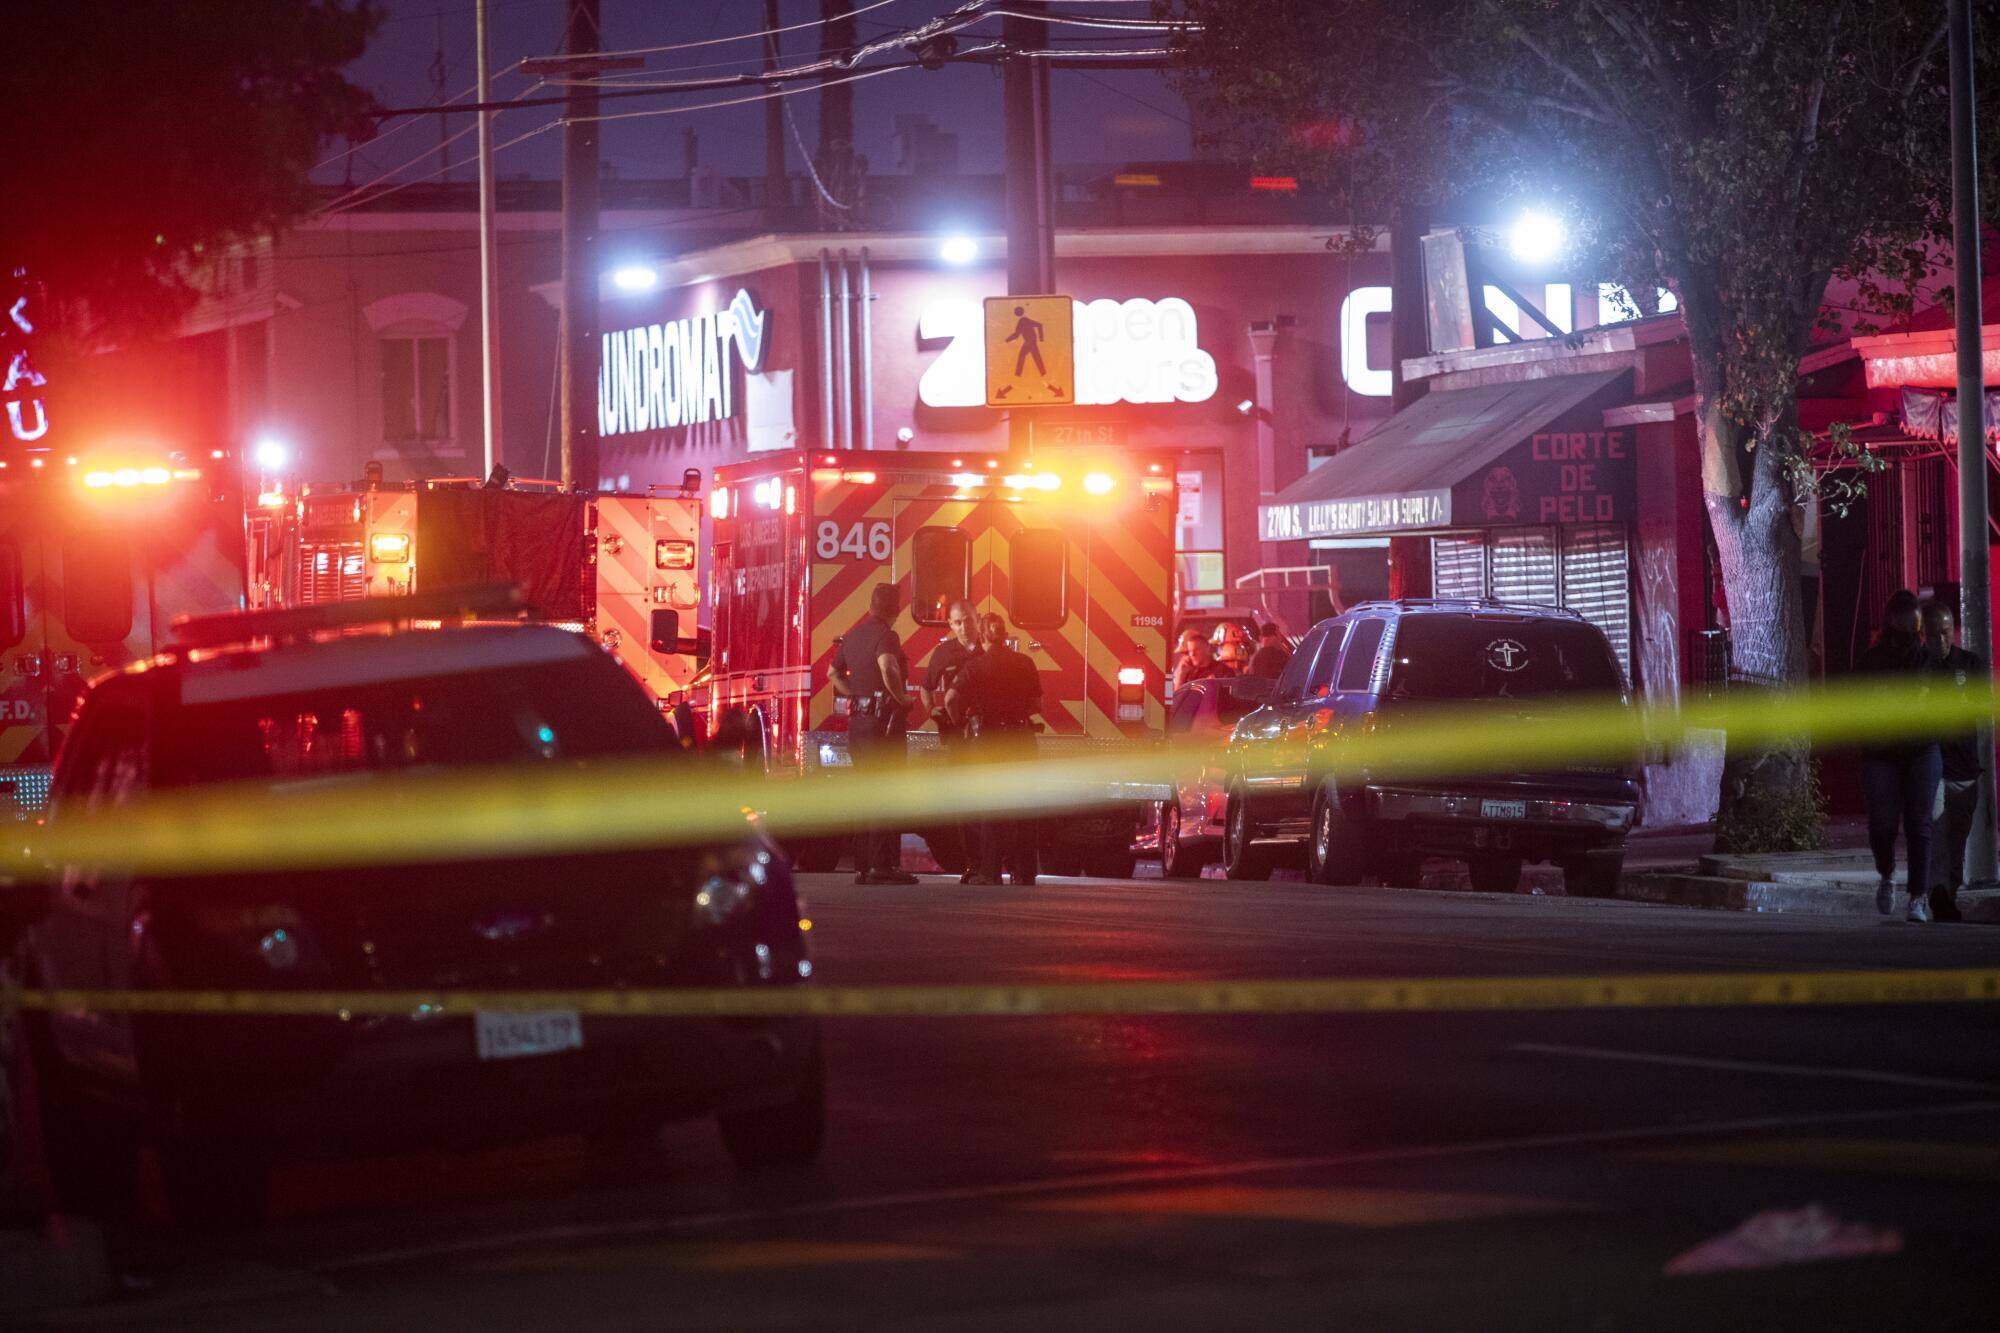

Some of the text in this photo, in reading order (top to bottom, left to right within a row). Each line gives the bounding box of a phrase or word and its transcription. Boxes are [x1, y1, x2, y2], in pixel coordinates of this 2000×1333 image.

[1532, 431, 1625, 461] CORTE
[1560, 464, 1597, 492] DE
[1338, 502, 1366, 530] BEAUTY
[1401, 496, 1429, 524] SUPPLY
[1539, 495, 1614, 523] PELO
[816, 520, 892, 561] 846
[1134, 616, 1164, 626] 11984
